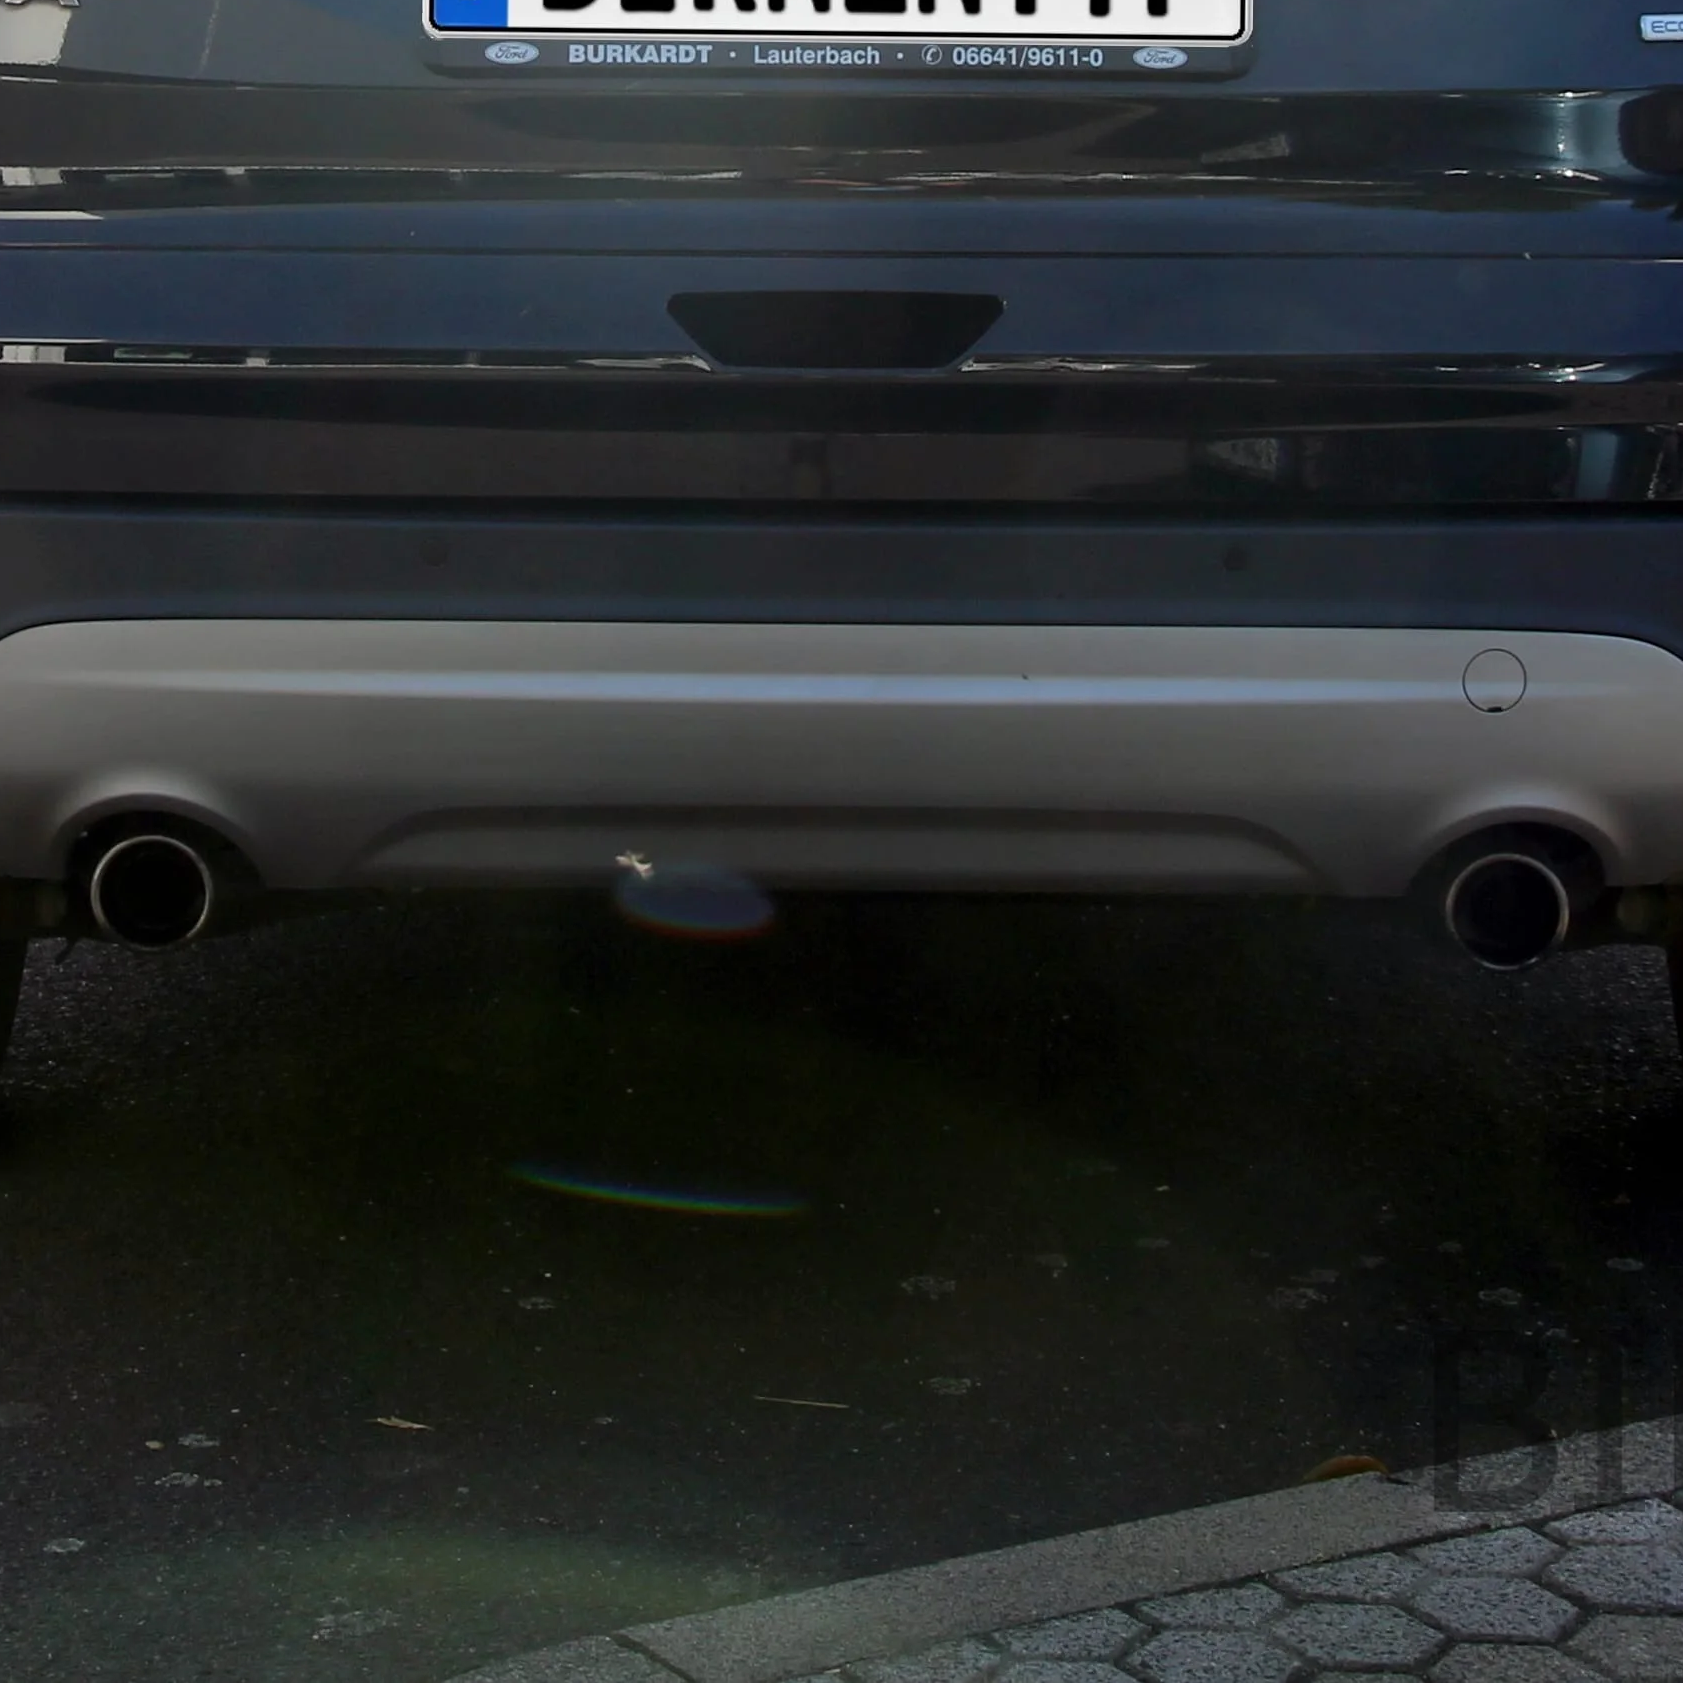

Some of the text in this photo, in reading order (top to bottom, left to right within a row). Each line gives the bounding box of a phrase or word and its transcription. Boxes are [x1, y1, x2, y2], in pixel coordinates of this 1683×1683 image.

[568, 44, 1104, 67] BURKARDT Lauterbach 06641/9611-0
